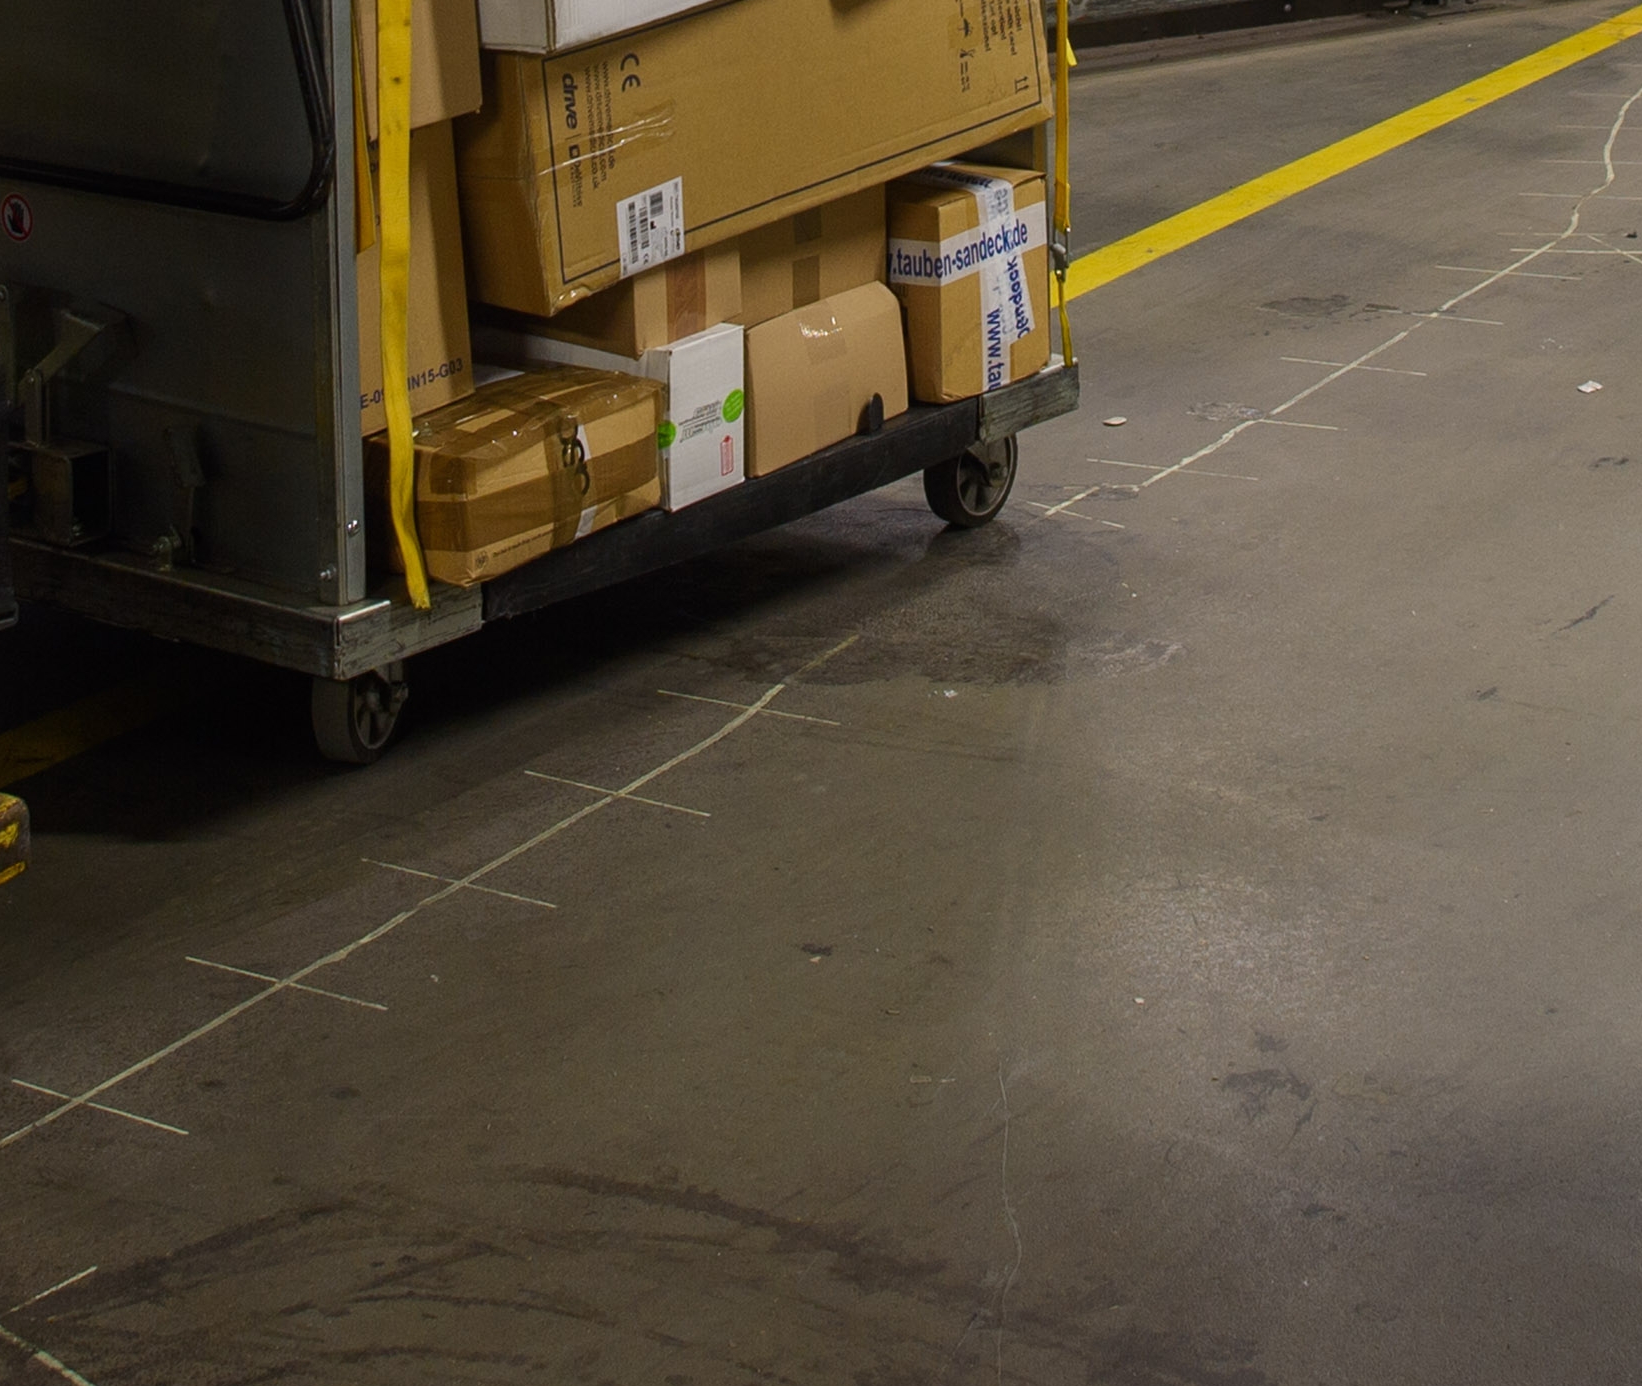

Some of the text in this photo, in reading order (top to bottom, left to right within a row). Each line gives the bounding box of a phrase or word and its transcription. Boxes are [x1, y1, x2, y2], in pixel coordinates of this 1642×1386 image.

[562, 73, 578, 130] drive
[888, 219, 1028, 279] .tauben-sandeck.de
[987, 307, 1005, 391] www.tau
